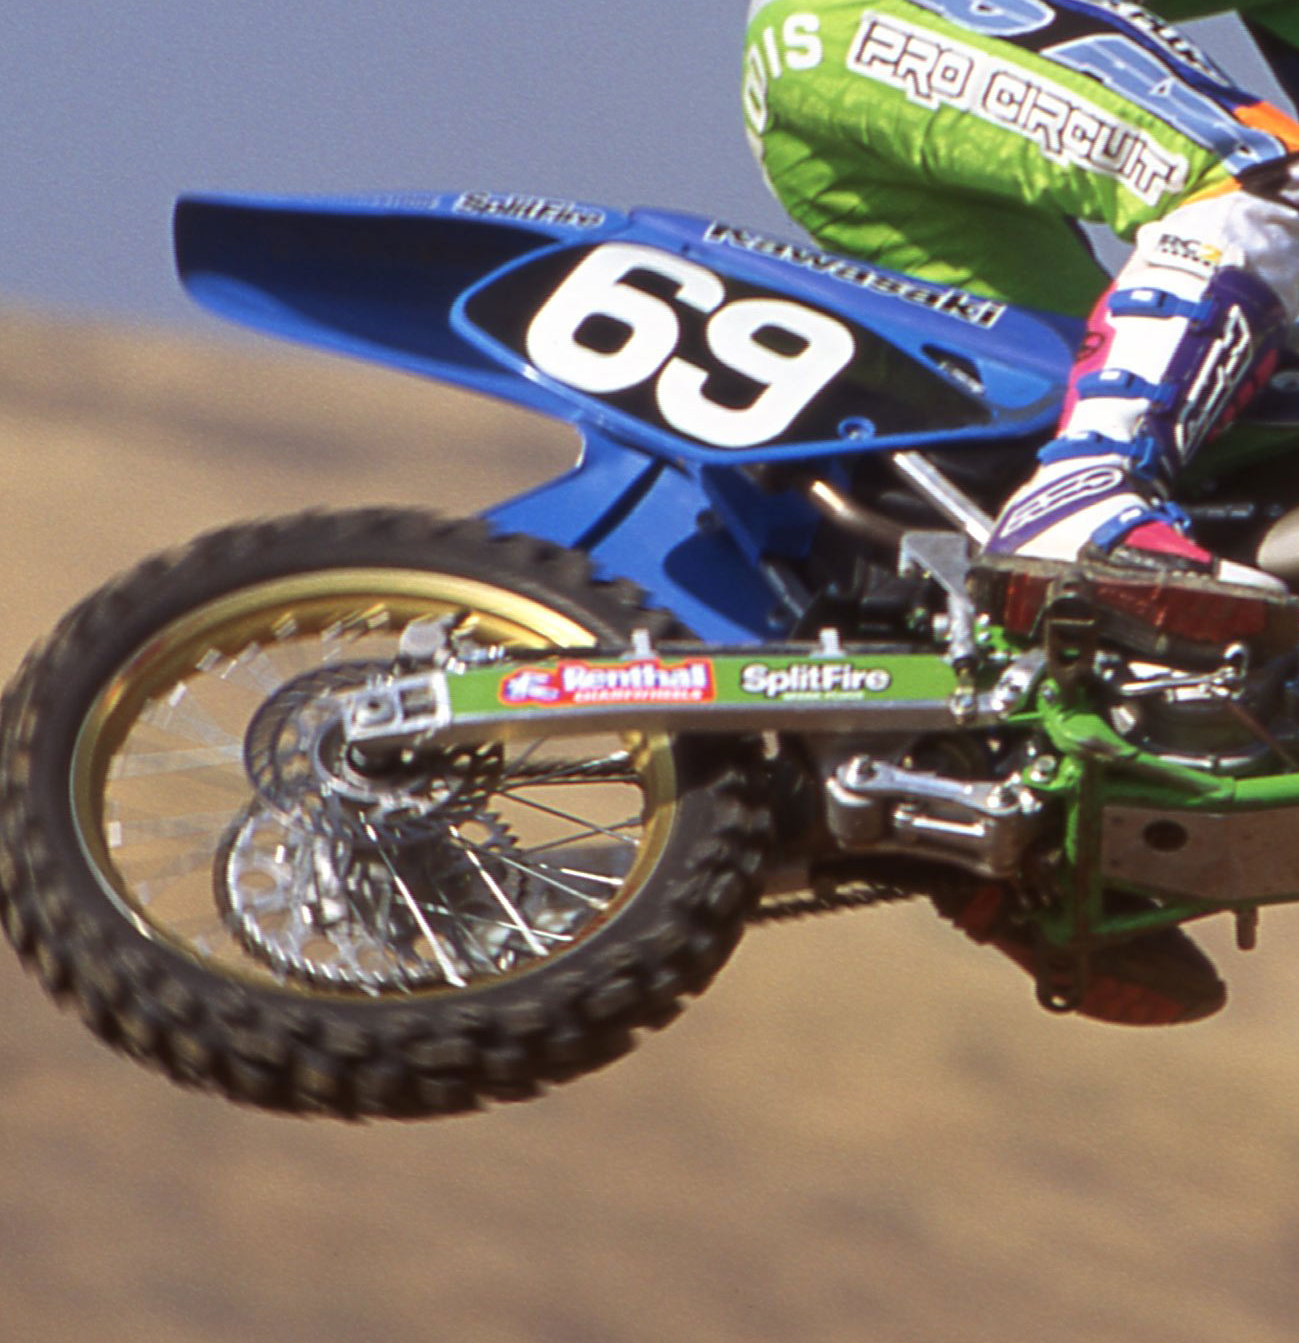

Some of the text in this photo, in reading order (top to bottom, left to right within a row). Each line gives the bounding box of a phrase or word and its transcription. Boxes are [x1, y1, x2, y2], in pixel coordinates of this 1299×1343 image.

[855, 19, 1182, 196] PRO CIRCUIT
[453, 191, 606, 229] SplitFire
[703, 220, 1008, 330] Kawasaki
[526, 241, 856, 448] 69
[561, 664, 707, 693] Renthal
[740, 663, 891, 699] SplitFire
